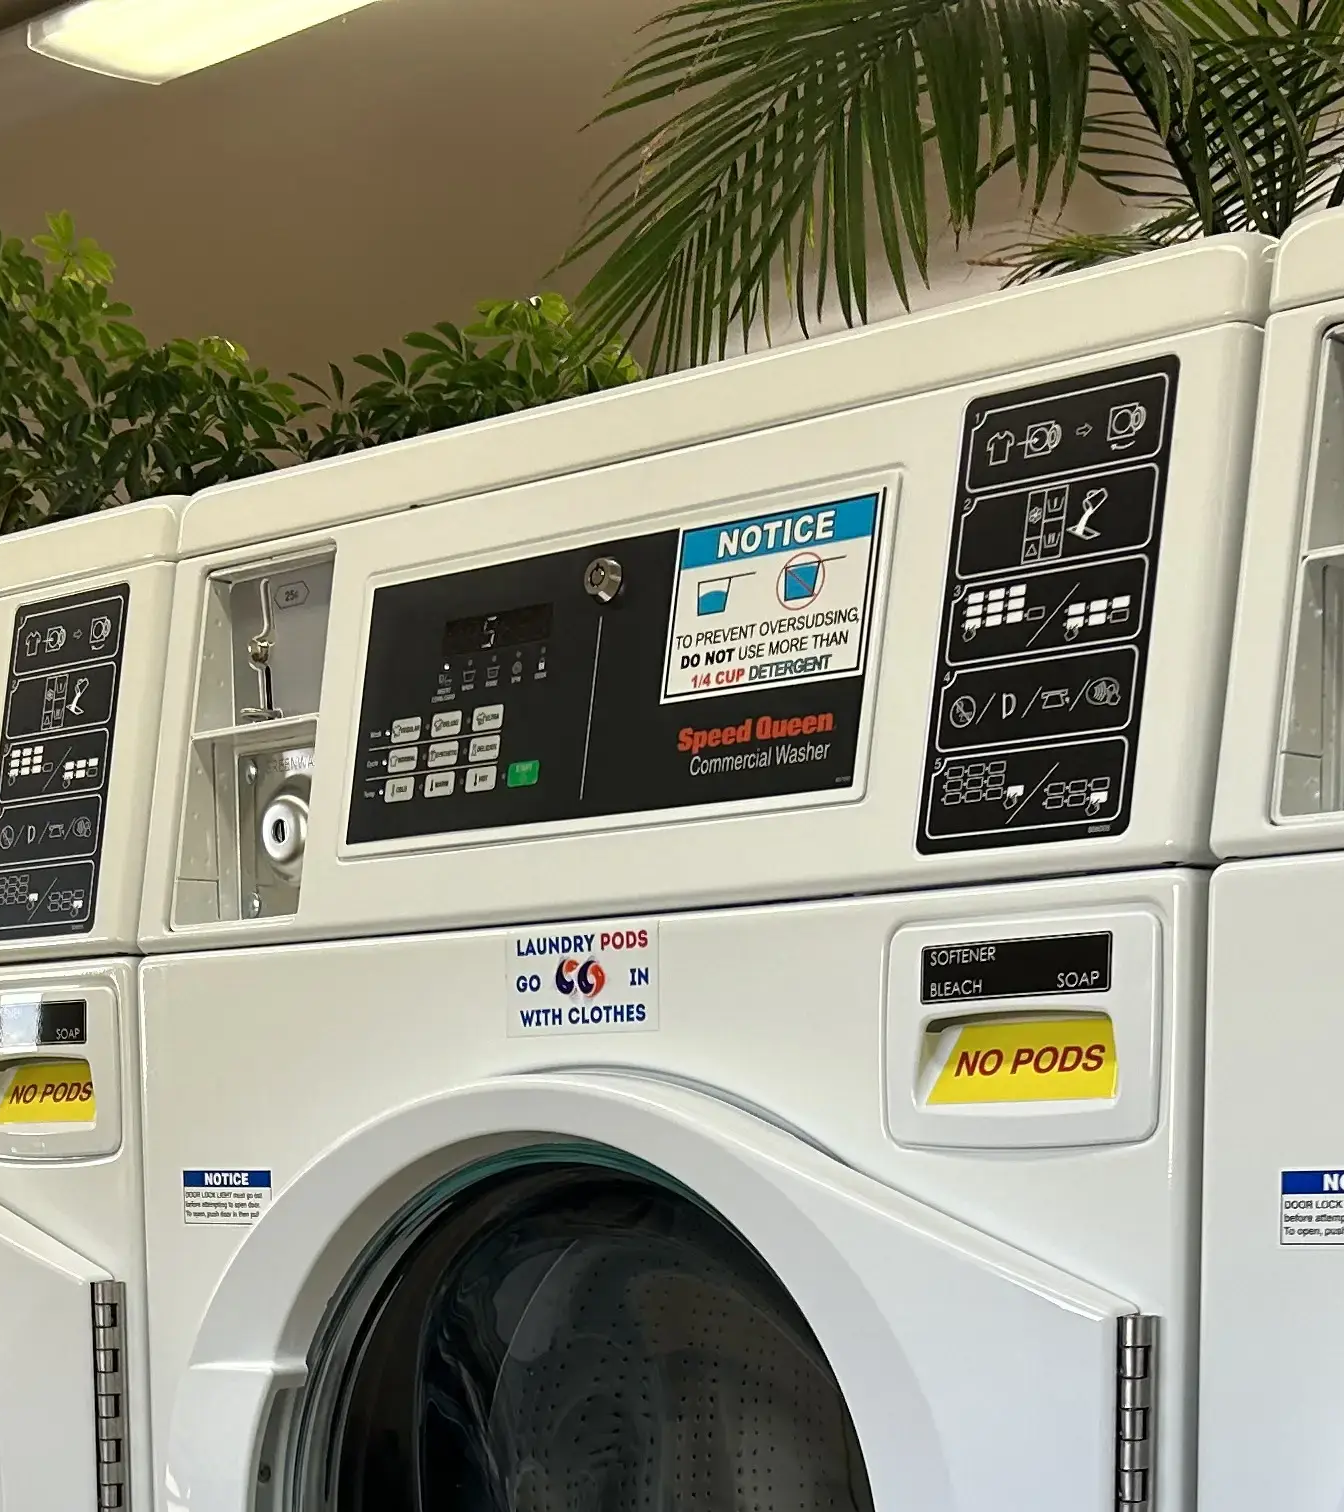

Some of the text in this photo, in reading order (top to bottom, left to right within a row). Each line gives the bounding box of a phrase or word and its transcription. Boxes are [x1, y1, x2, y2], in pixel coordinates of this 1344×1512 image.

[717, 510, 836, 559] NOTICE
[676, 607, 860, 650] TO PREVENT OVERSUDSING,
[680, 630, 849, 669] DO NOT USE MORE THAN
[691, 654, 832, 688] 1/4 CUP DETERGENT
[678, 712, 834, 754] Speed Queen
[689, 741, 831, 776] Commercial Washer
[517, 930, 648, 956] LAUNDRY PODS
[930, 946, 996, 967] SOFTENER
[516, 967, 649, 992] GO IN
[930, 971, 1100, 997] BLEACH SOAP
[520, 1004, 646, 1027] WITH CLOTHES
[56, 1028, 80, 1040] SOAP
[954, 1044, 1106, 1077] NO PODS
[9, 1082, 93, 1104] NO PODS
[204, 1172, 249, 1186] NOTICE
[1284, 1200, 1313, 1209] DOOR
[1315, 1200, 1343, 1209] LOCK
[1284, 1213, 1313, 1222] before
[1284, 1226, 1295, 1235] To
